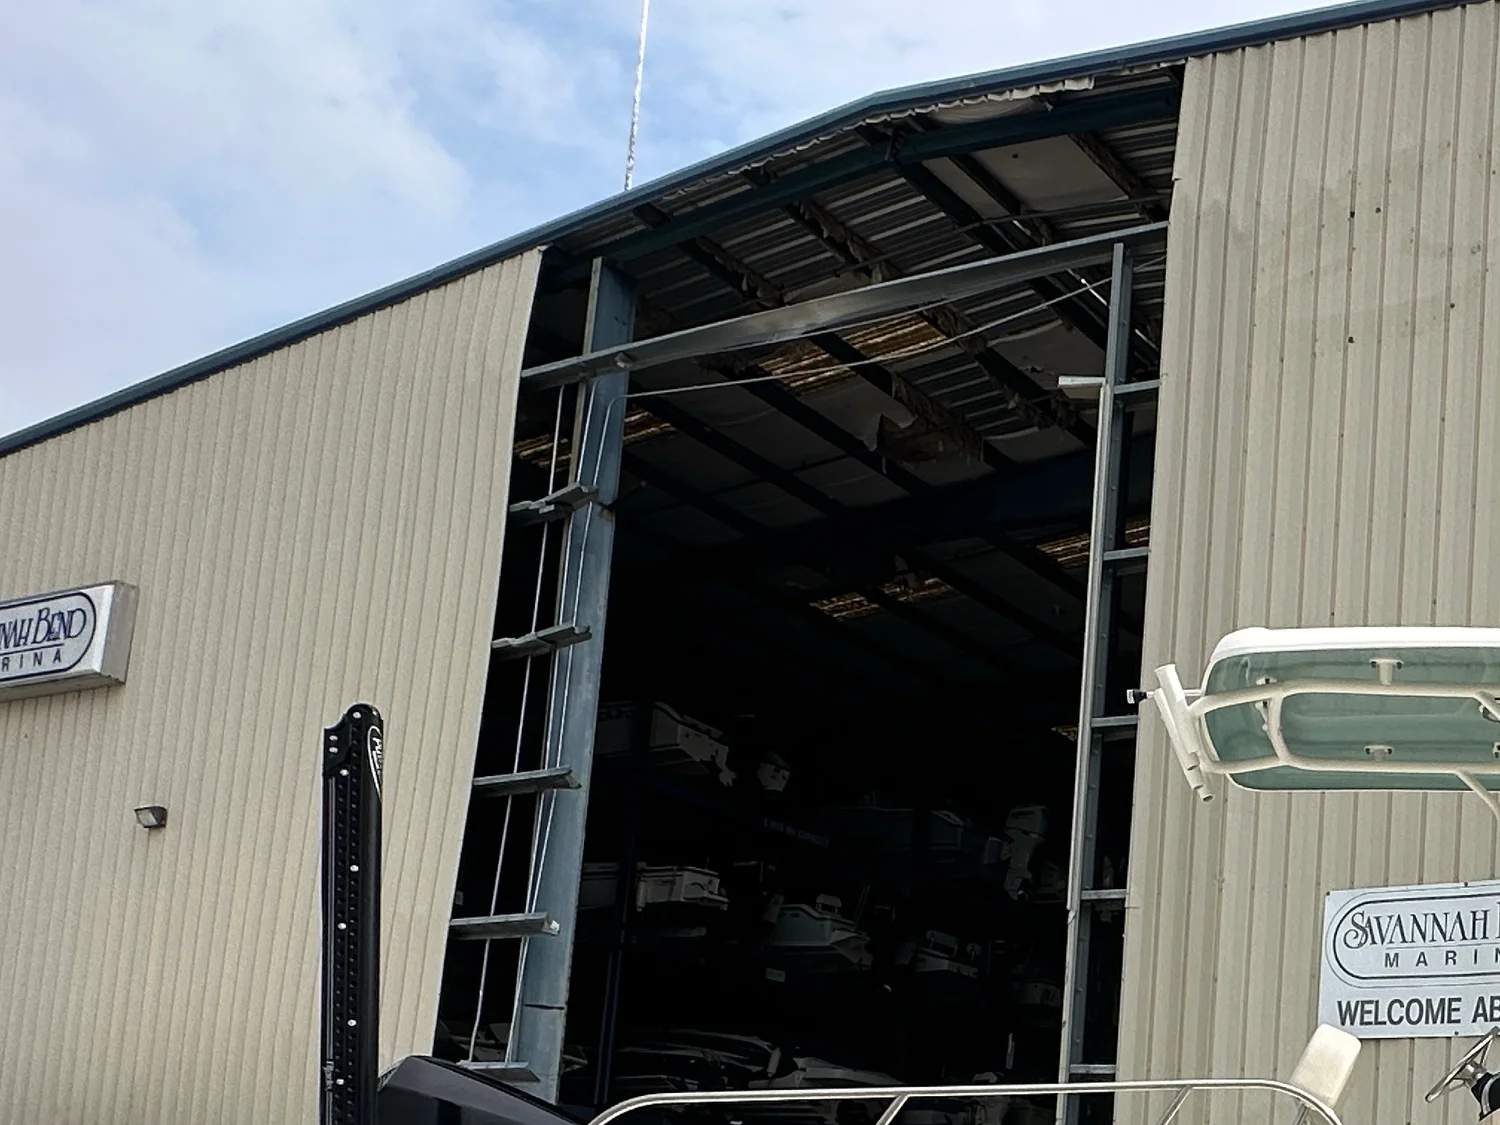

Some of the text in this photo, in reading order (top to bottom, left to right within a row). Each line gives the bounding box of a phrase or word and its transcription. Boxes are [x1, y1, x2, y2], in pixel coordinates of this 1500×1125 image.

[31, 606, 87, 644] BEND
[1343, 908, 1491, 949] SAVANNAH
[1337, 997, 1462, 1027] WELCOME
